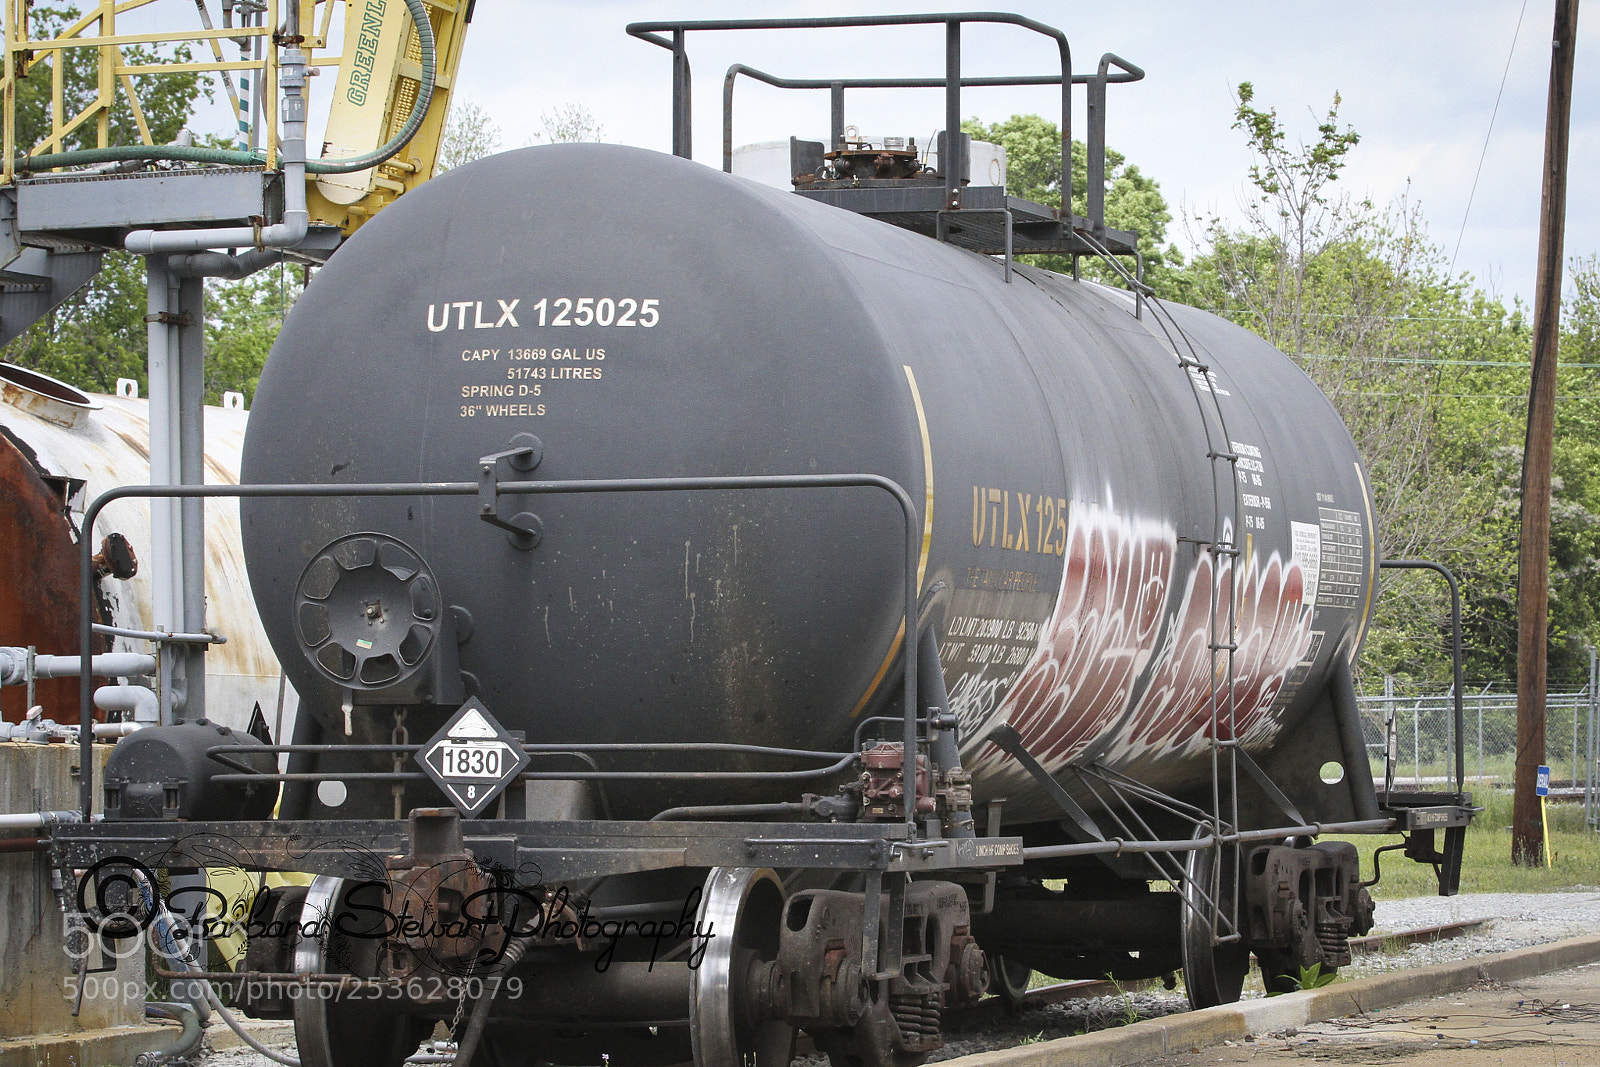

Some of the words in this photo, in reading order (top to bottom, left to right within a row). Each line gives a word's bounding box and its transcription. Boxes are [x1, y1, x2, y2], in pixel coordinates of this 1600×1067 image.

[347, 0, 387, 106] GREENL
[427, 298, 520, 332] UTLX
[533, 297, 660, 328] 125025
[461, 349, 500, 361] CAPY
[507, 348, 547, 360] 13669
[551, 348, 581, 360] GAL
[585, 348, 606, 360] US
[506, 367, 547, 379] 51743
[550, 367, 602, 379] LITRES
[461, 385, 514, 398] SPRING
[518, 384, 541, 396] D-5
[485, 404, 546, 416] WHEELS
[972, 485, 1030, 552] UTLX
[445, 749, 499, 775] 1830
[467, 785, 476, 799] 8
